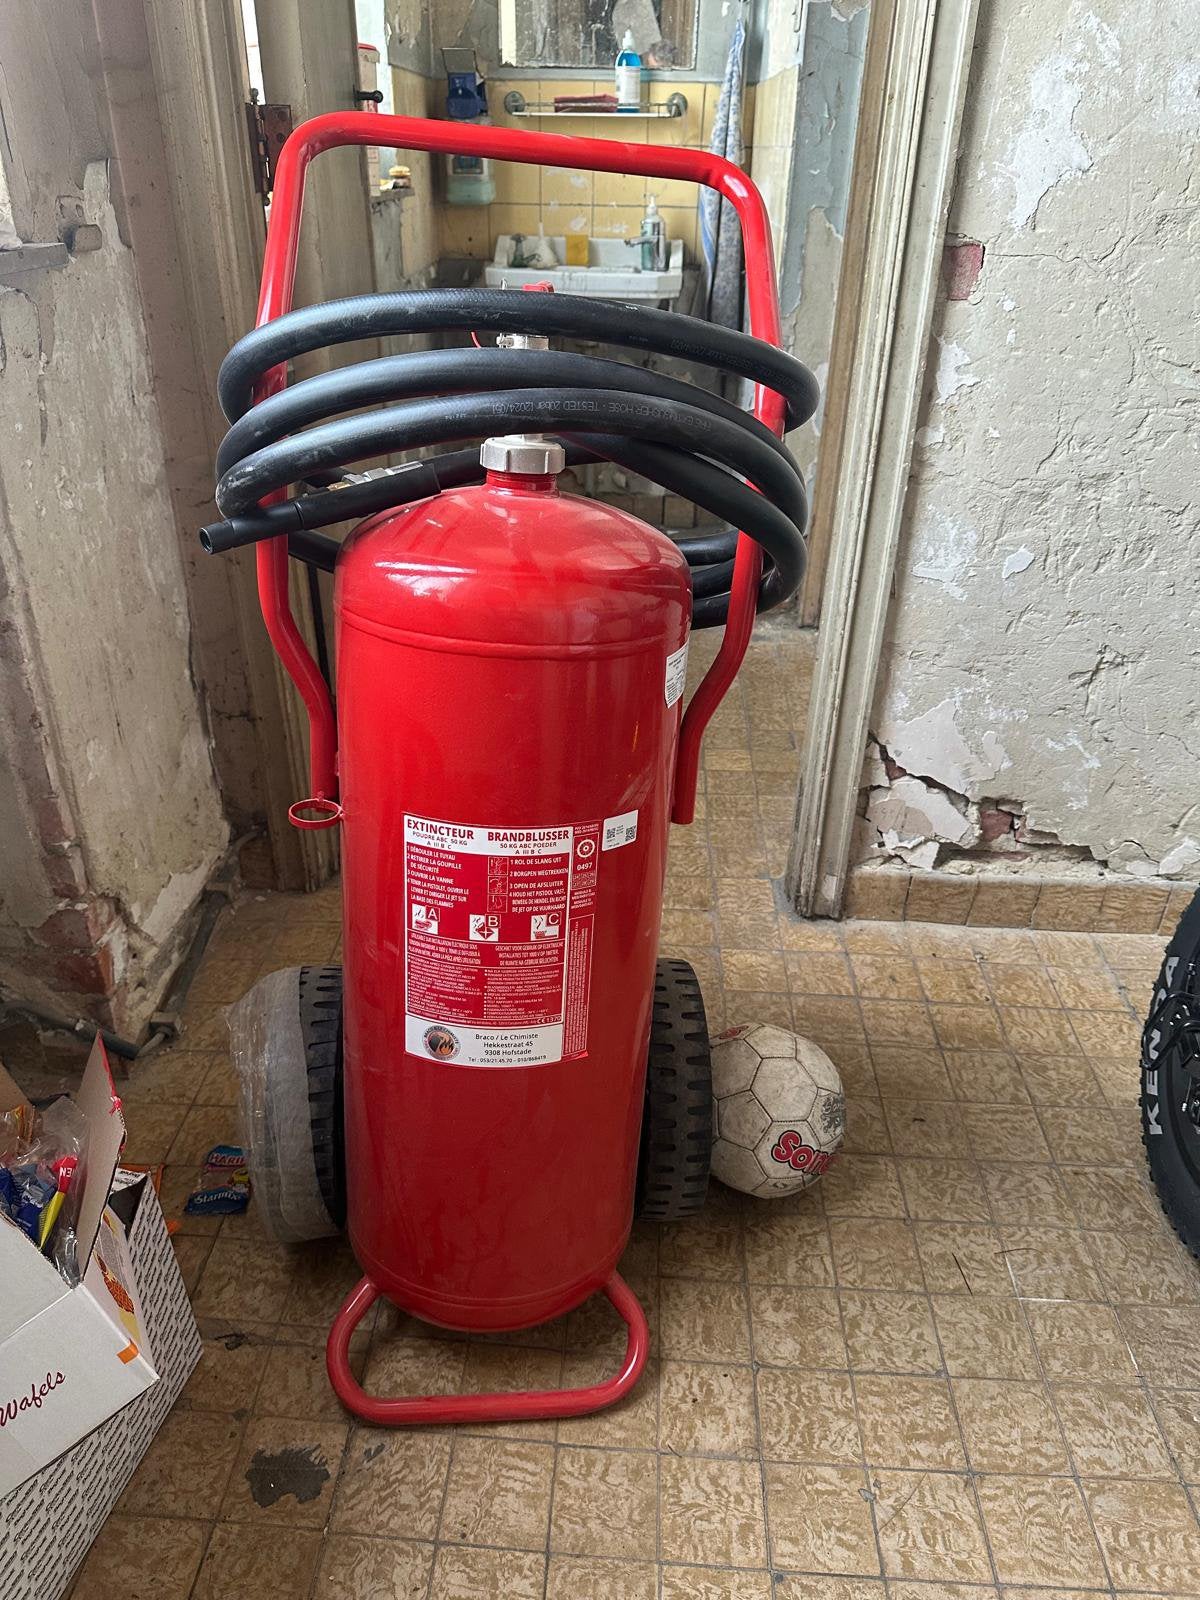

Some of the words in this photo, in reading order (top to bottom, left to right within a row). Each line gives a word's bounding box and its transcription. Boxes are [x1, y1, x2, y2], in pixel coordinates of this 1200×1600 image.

[562, 401, 600, 411] TESTED
[608, 402, 634, 414] HOSE
[407, 819, 474, 840] EXTINCTEUR
[412, 831, 434, 841] POUDRE
[435, 834, 449, 843] ABC
[487, 830, 570, 842] BRANDBLUSSER
[533, 841, 557, 849] POEDER
[437, 861, 462, 870] GOUPILLE
[534, 857, 552, 865] SLANG
[576, 861, 593, 871] 0497
[429, 874, 436, 882] LA
[427, 910, 438, 920] A
[548, 914, 559, 925] C
[487, 916, 499, 927] B
[475, 1033, 495, 1041] Braco
[509, 1032, 538, 1041] Chimiste
[483, 1041, 524, 1049] Hekkestraat
[502, 1048, 532, 1056] Hofstade
[194, 1191, 241, 1204] Starmix
[0, 1371, 66, 1427] Wafels
